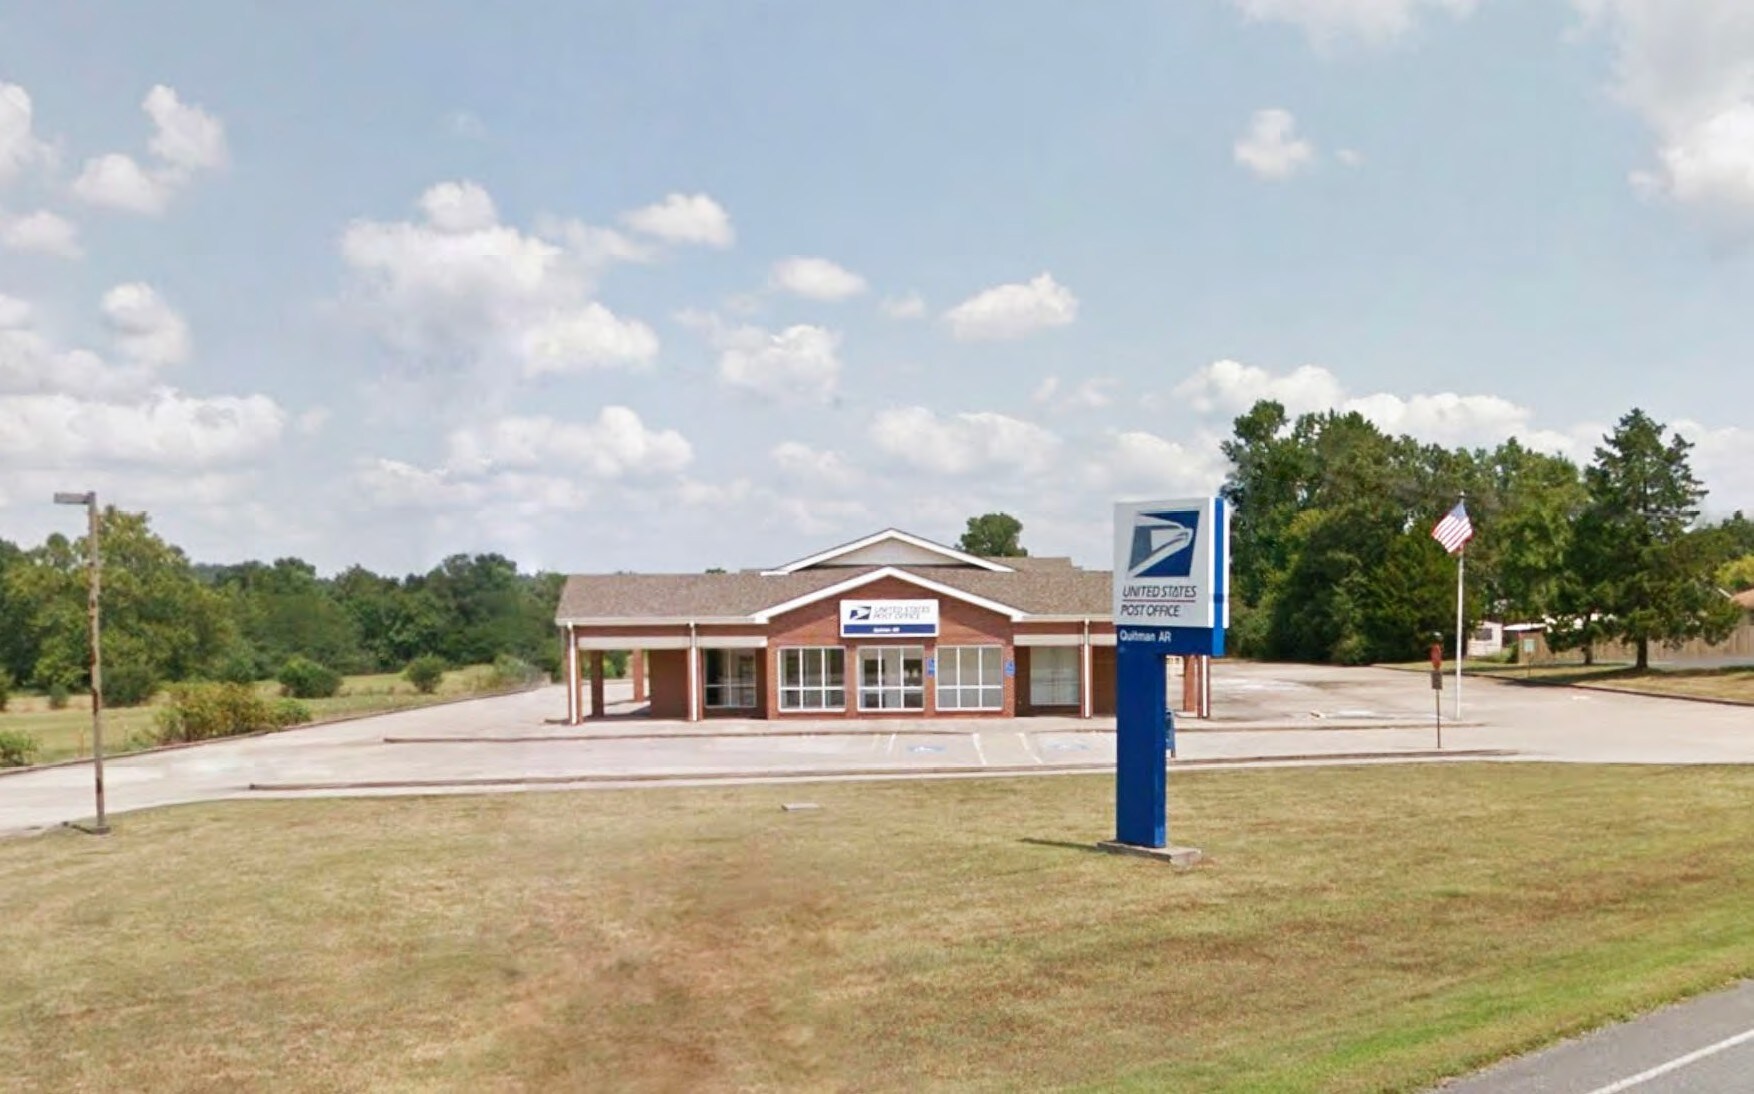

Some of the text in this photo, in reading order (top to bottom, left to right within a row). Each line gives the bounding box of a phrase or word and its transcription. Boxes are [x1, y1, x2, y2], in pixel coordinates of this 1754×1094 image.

[1123, 585, 1197, 598] UNITED STATES
[1121, 604, 1180, 617] POST OFFICE
[1120, 629, 1172, 642] Quitman AR
